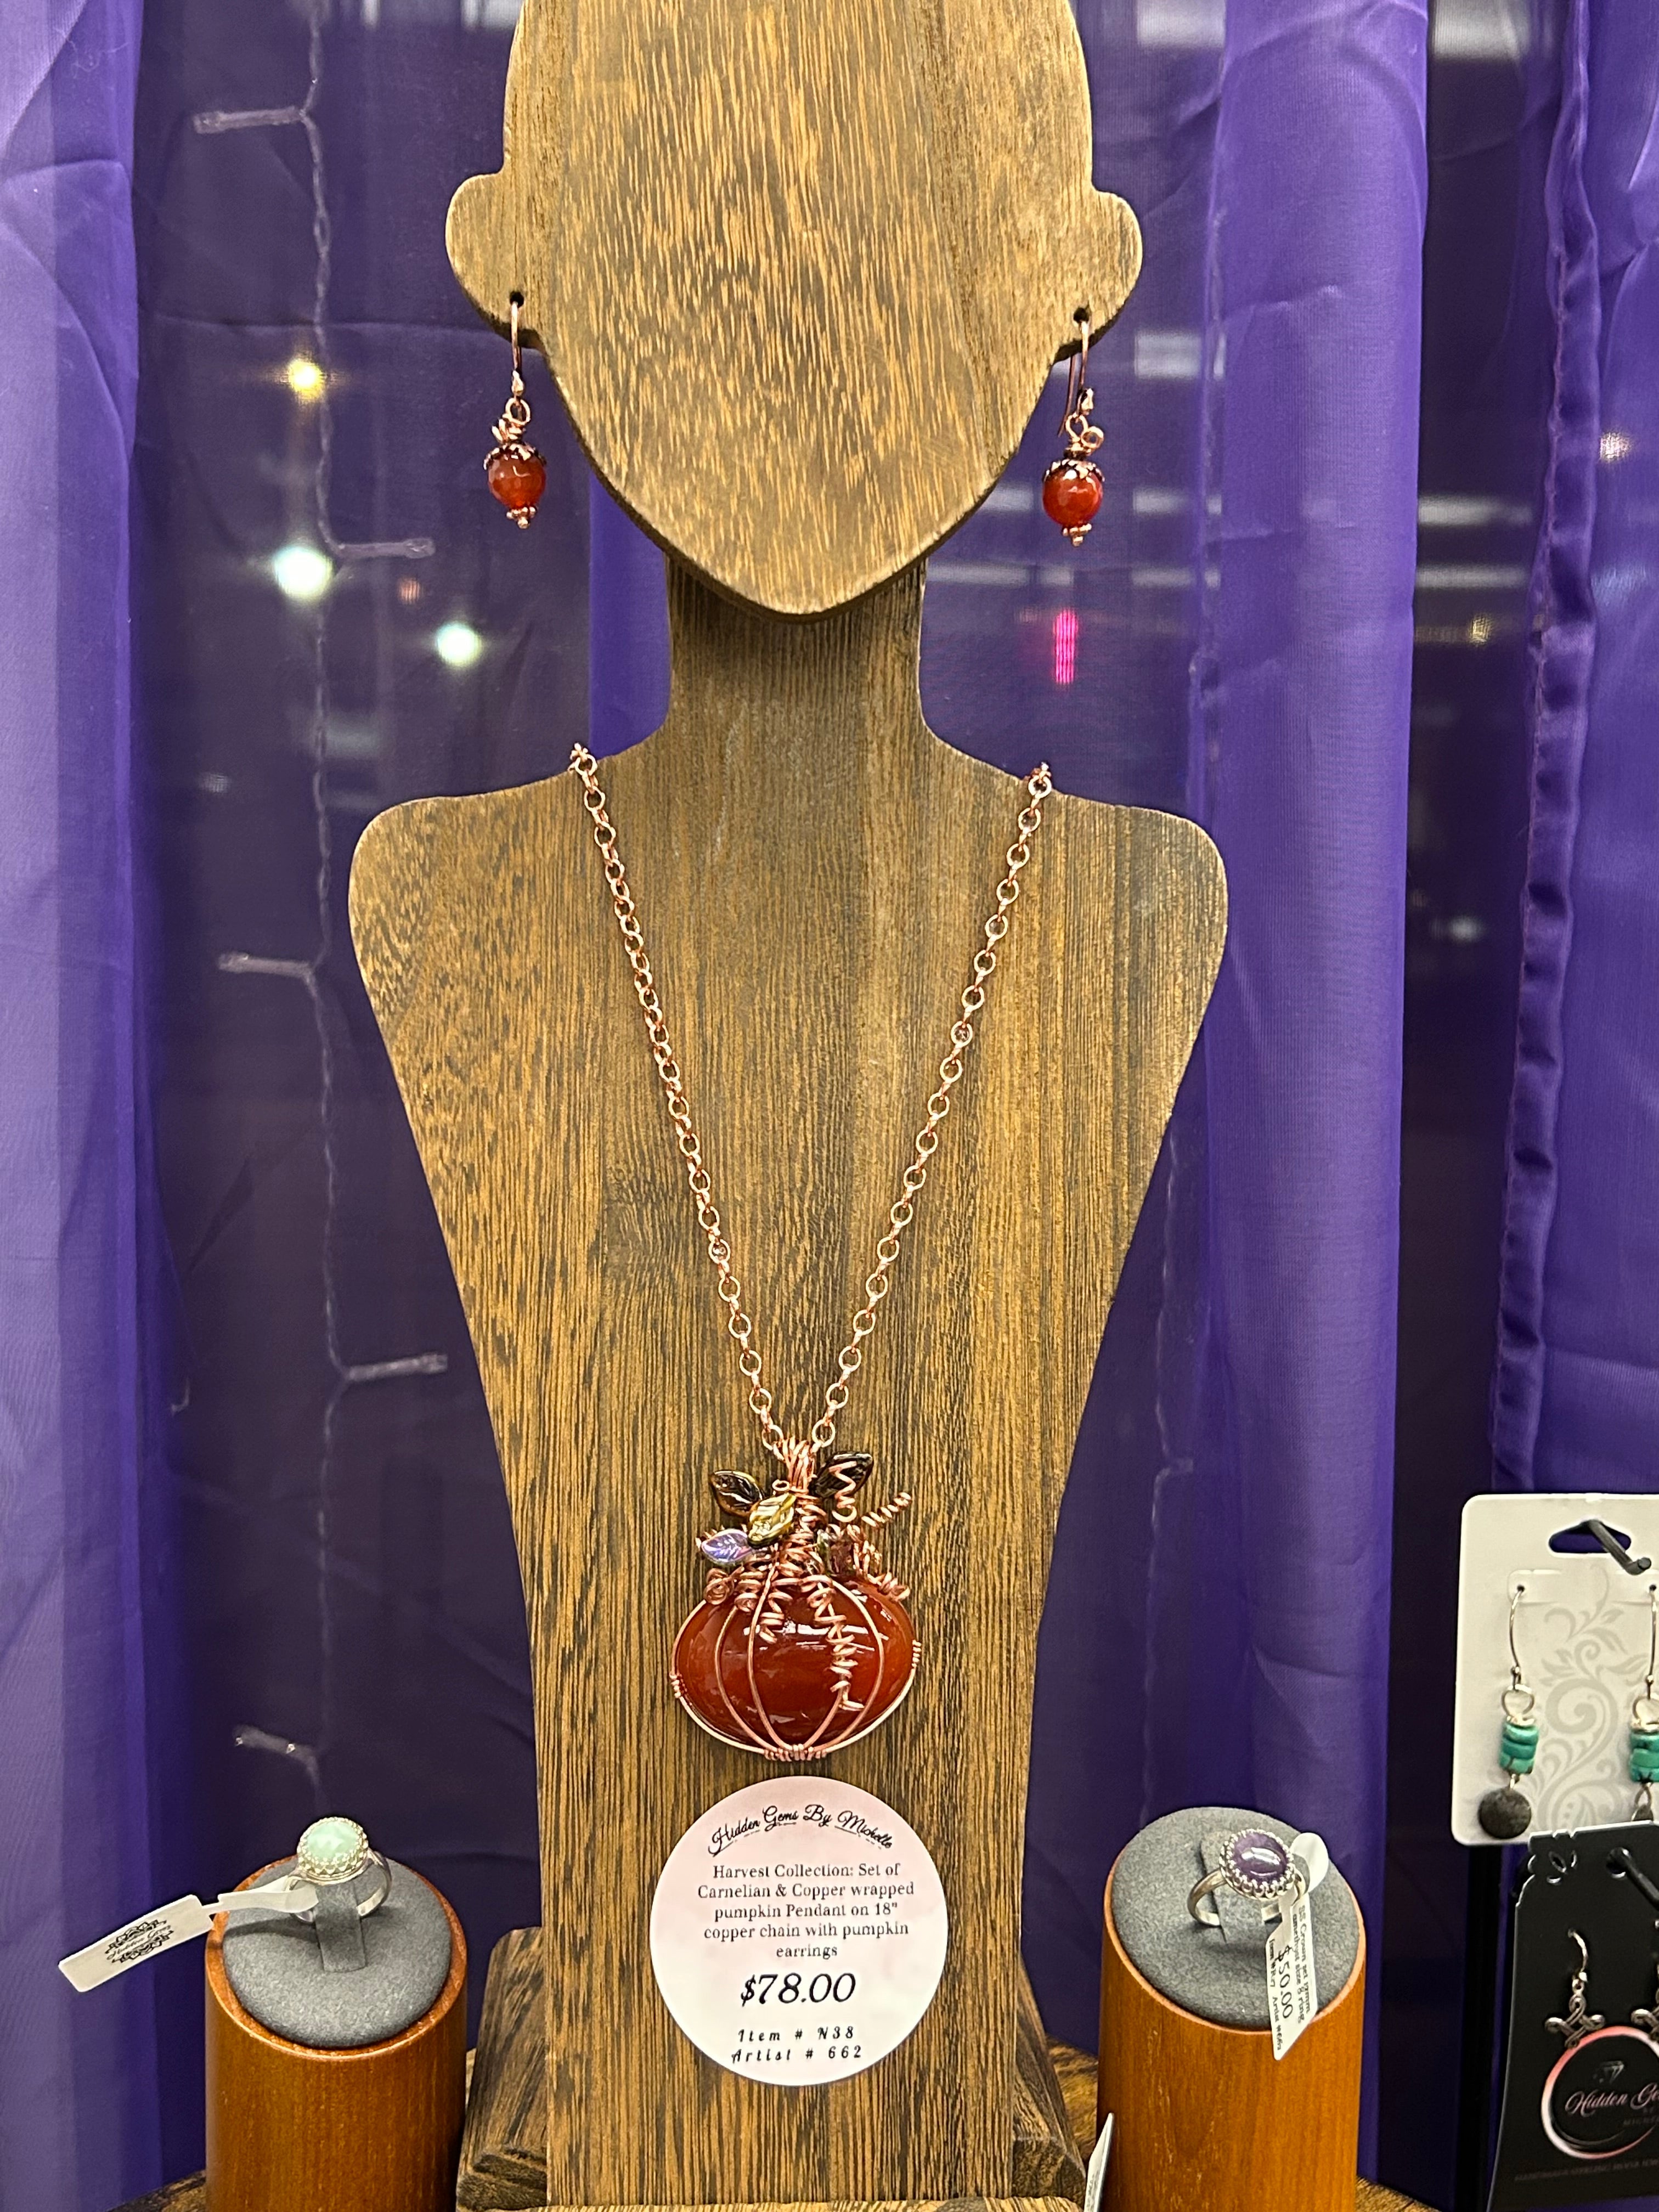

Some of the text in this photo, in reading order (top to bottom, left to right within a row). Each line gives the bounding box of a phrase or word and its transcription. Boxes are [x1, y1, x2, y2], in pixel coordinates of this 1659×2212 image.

[708, 1804, 893, 1857] Hidden Gems By Michelle
[713, 1863, 900, 1879] Harvest Collection: Set of
[698, 1882, 915, 1900] Carnelian & Copper wrapped
[715, 1902, 898, 1922] pumpkin Pendant on 18"
[704, 1922, 909, 1941] copper chain with pumpkin
[776, 1944, 838, 1960] earrings
[740, 1972, 857, 2007] $78.00
[1274, 1944, 1293, 2018] $50.00
[738, 2025, 854, 2042] Item # N38
[731, 2045, 862, 2064] Artist # 662
[1565, 2089, 1628, 2118] Hidden
